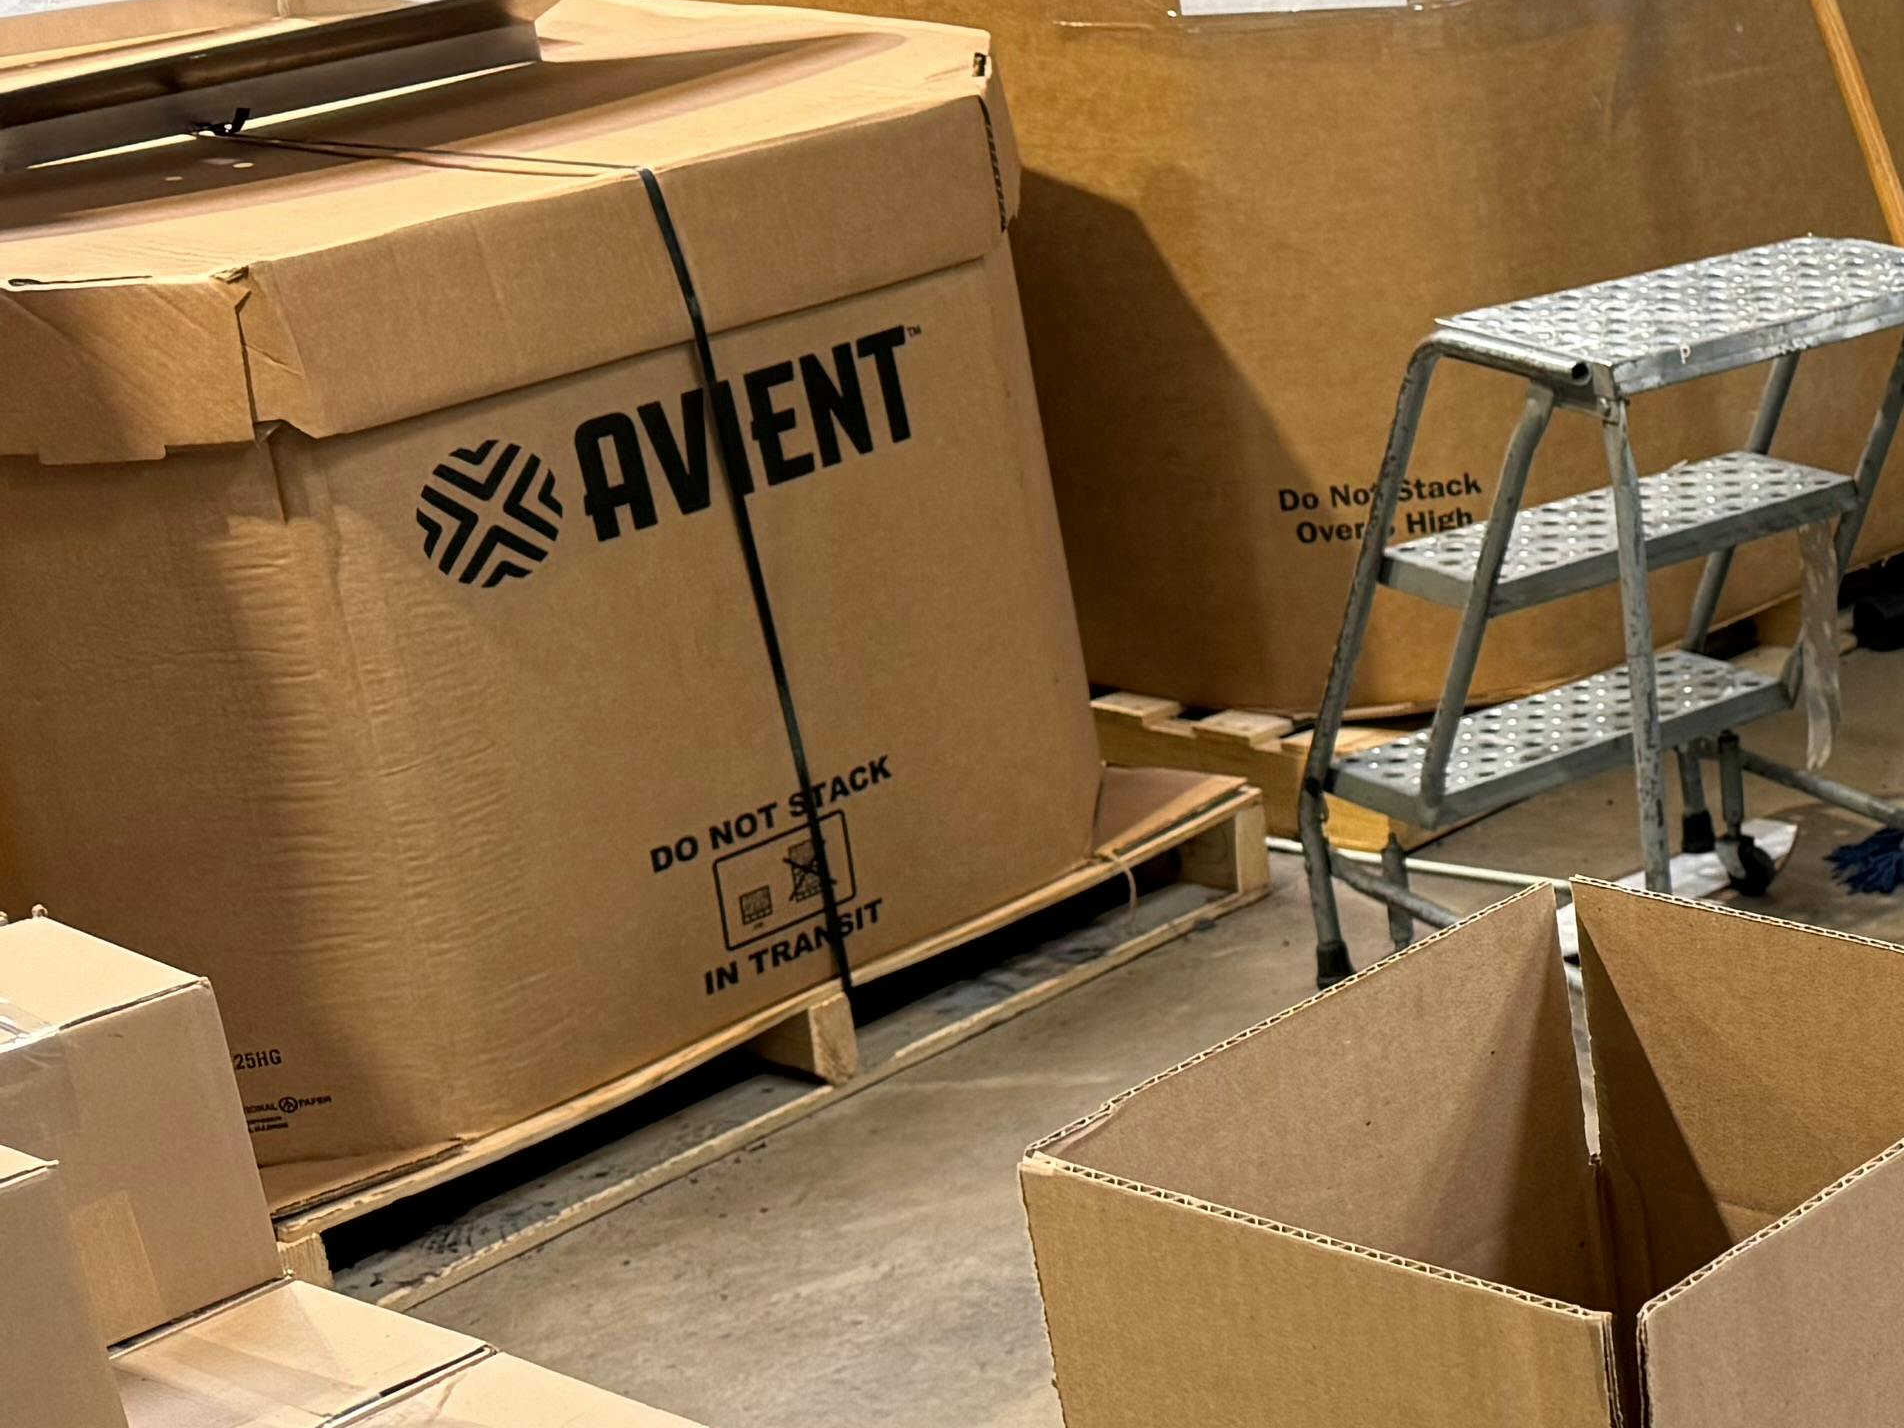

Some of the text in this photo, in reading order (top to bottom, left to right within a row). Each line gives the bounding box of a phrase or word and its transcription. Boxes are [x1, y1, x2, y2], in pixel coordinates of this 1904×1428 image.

[574, 324, 912, 543] AVIENT
[1278, 488, 1319, 512] Do
[1398, 472, 1482, 502] Stack
[1296, 522, 1365, 544] Over
[650, 754, 892, 873] DO NOT STACK
[704, 898, 883, 995] IN TRANSIT
